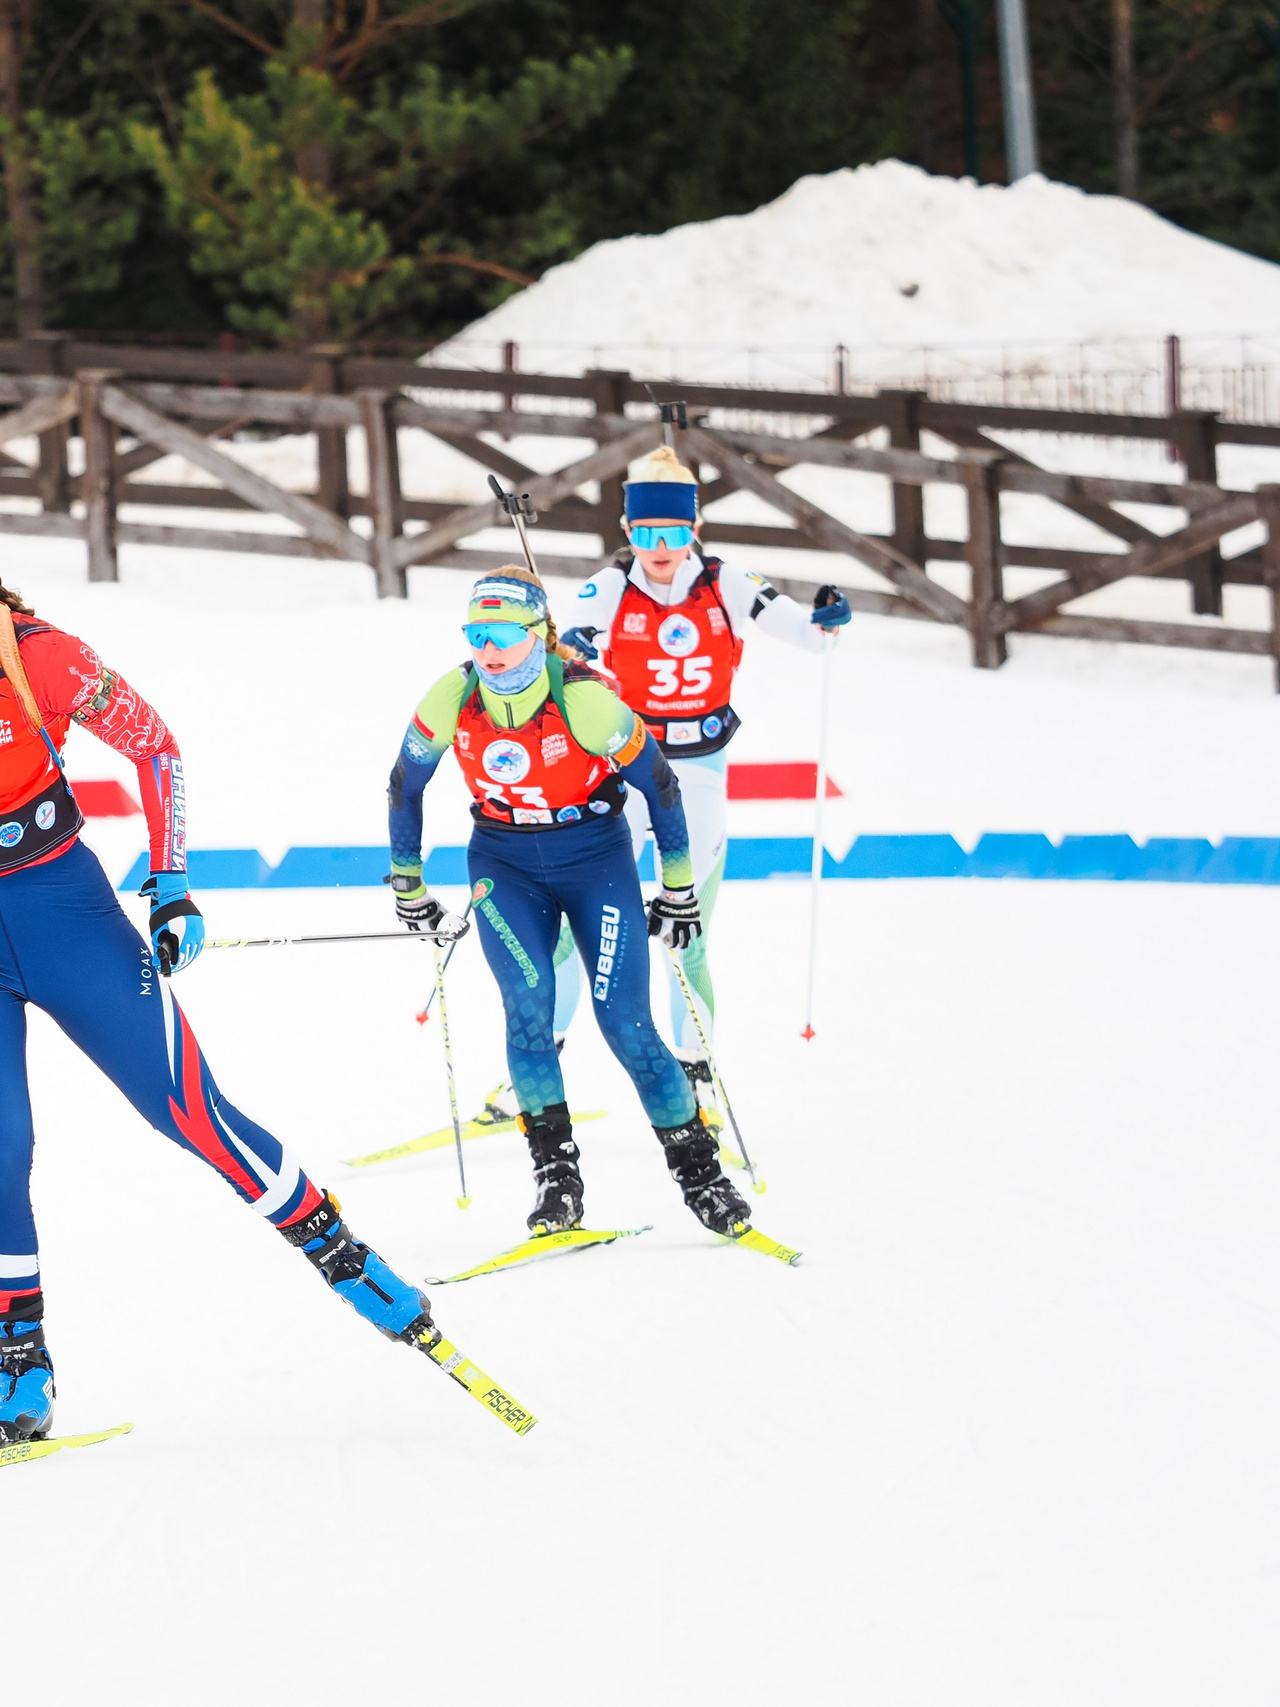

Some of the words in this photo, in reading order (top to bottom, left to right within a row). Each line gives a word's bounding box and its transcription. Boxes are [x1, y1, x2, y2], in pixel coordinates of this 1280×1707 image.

[647, 655, 712, 697] 35
[480, 898, 539, 988] БЕЛОРУСНЕФТЬ
[597, 904, 620, 976] BEEU
[140, 947, 152, 995] MOAX
[307, 1210, 328, 1231] 176
[319, 1239, 347, 1264] SPINE
[1, 1341, 34, 1353] SPINE
[482, 1388, 527, 1426] FISCHER
[0, 1445, 32, 1463] FISCHER
